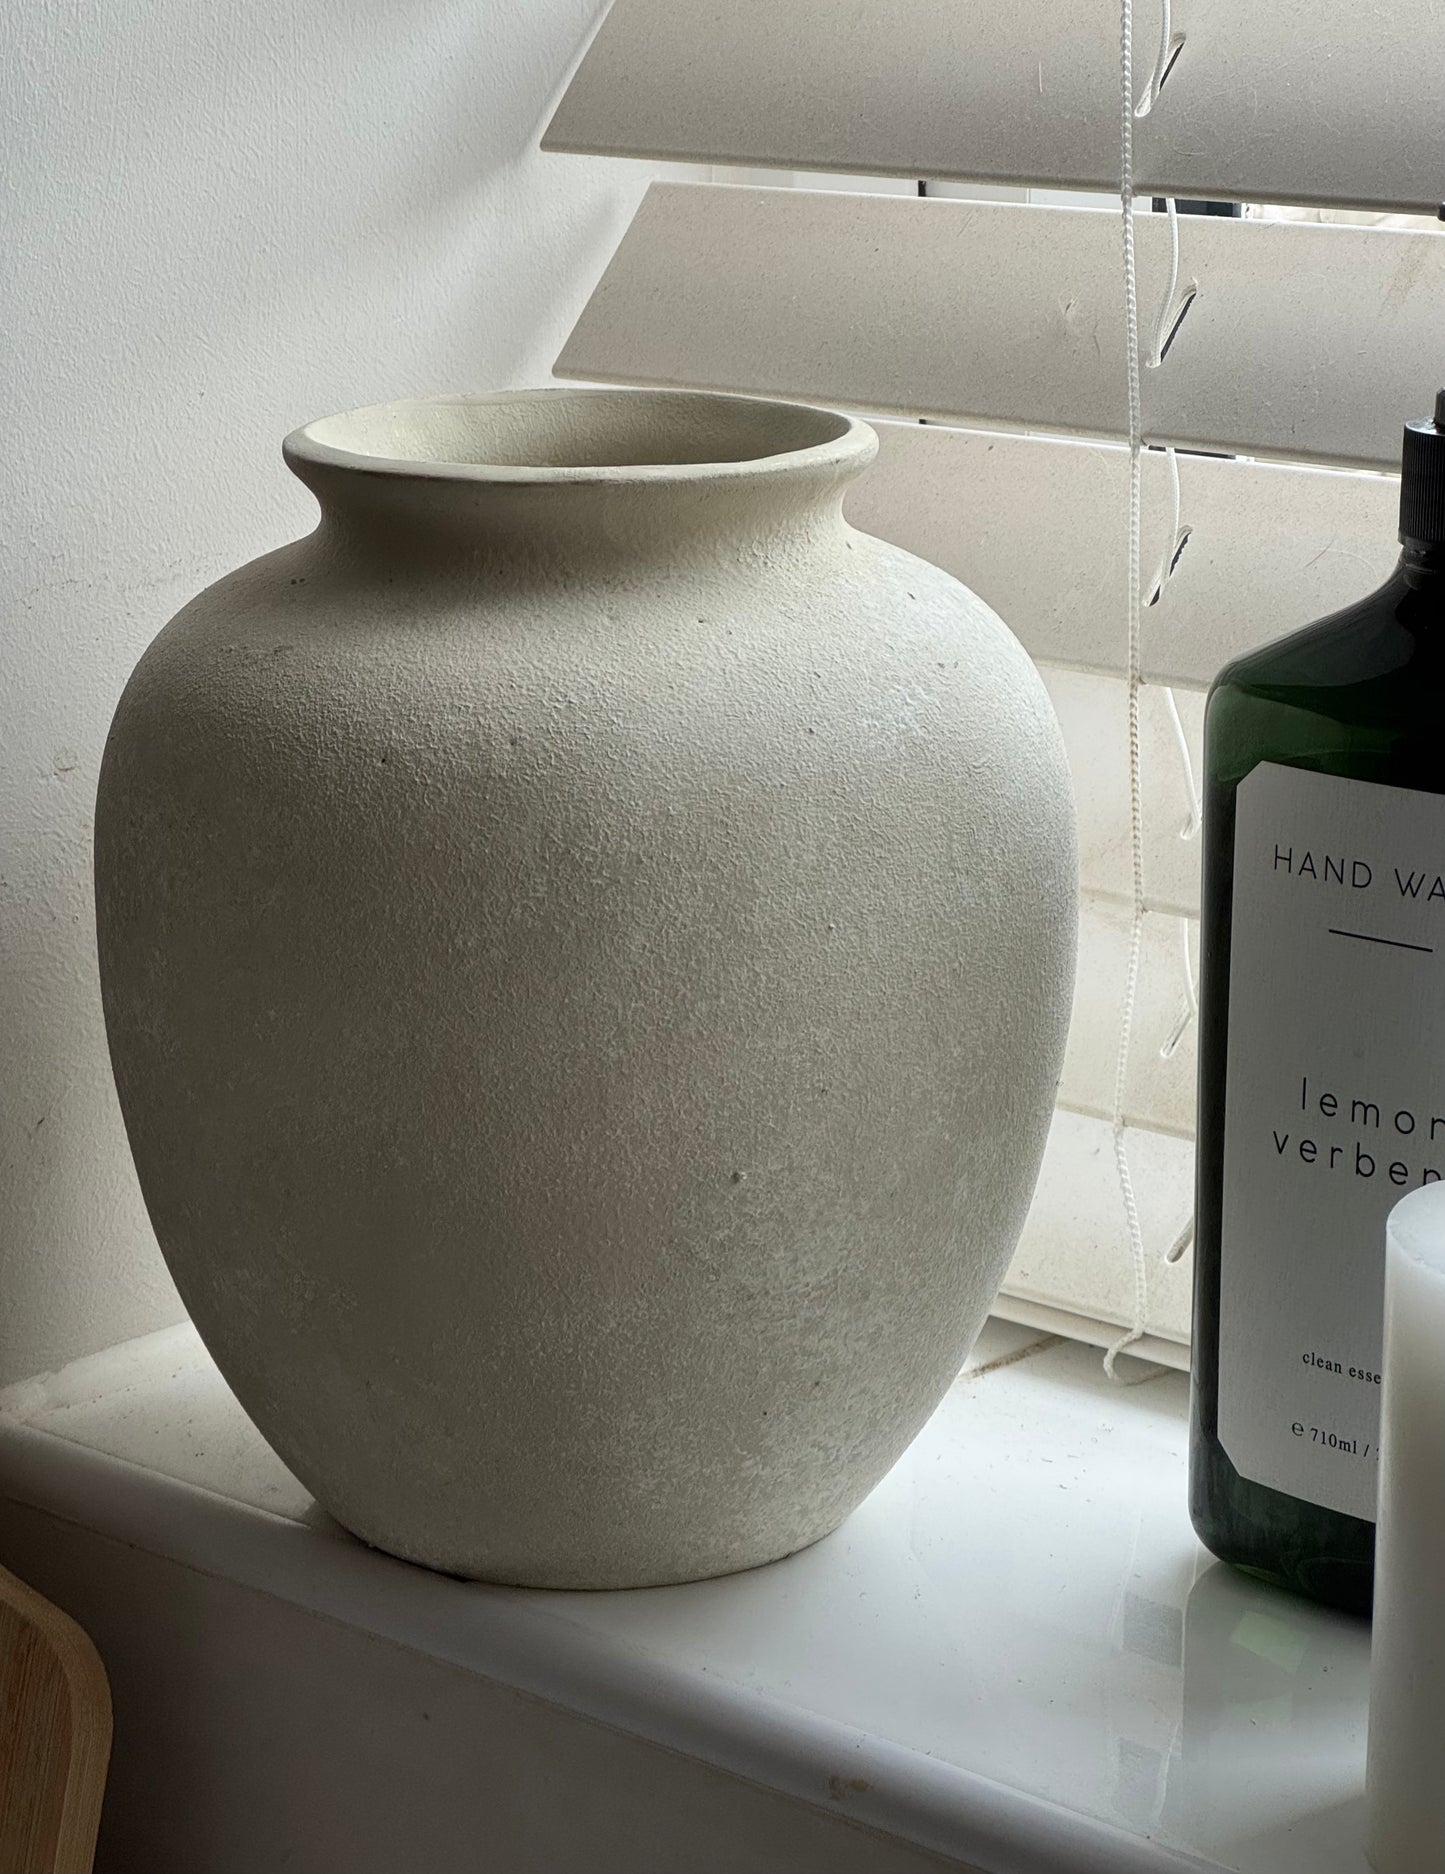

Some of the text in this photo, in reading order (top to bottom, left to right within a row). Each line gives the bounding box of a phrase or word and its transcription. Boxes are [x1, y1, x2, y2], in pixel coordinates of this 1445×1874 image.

[1273, 843, 1445, 902] HAND WA
[1302, 1351, 1382, 1385] clean esse
[1310, 1427, 1357, 1455] 710ml
